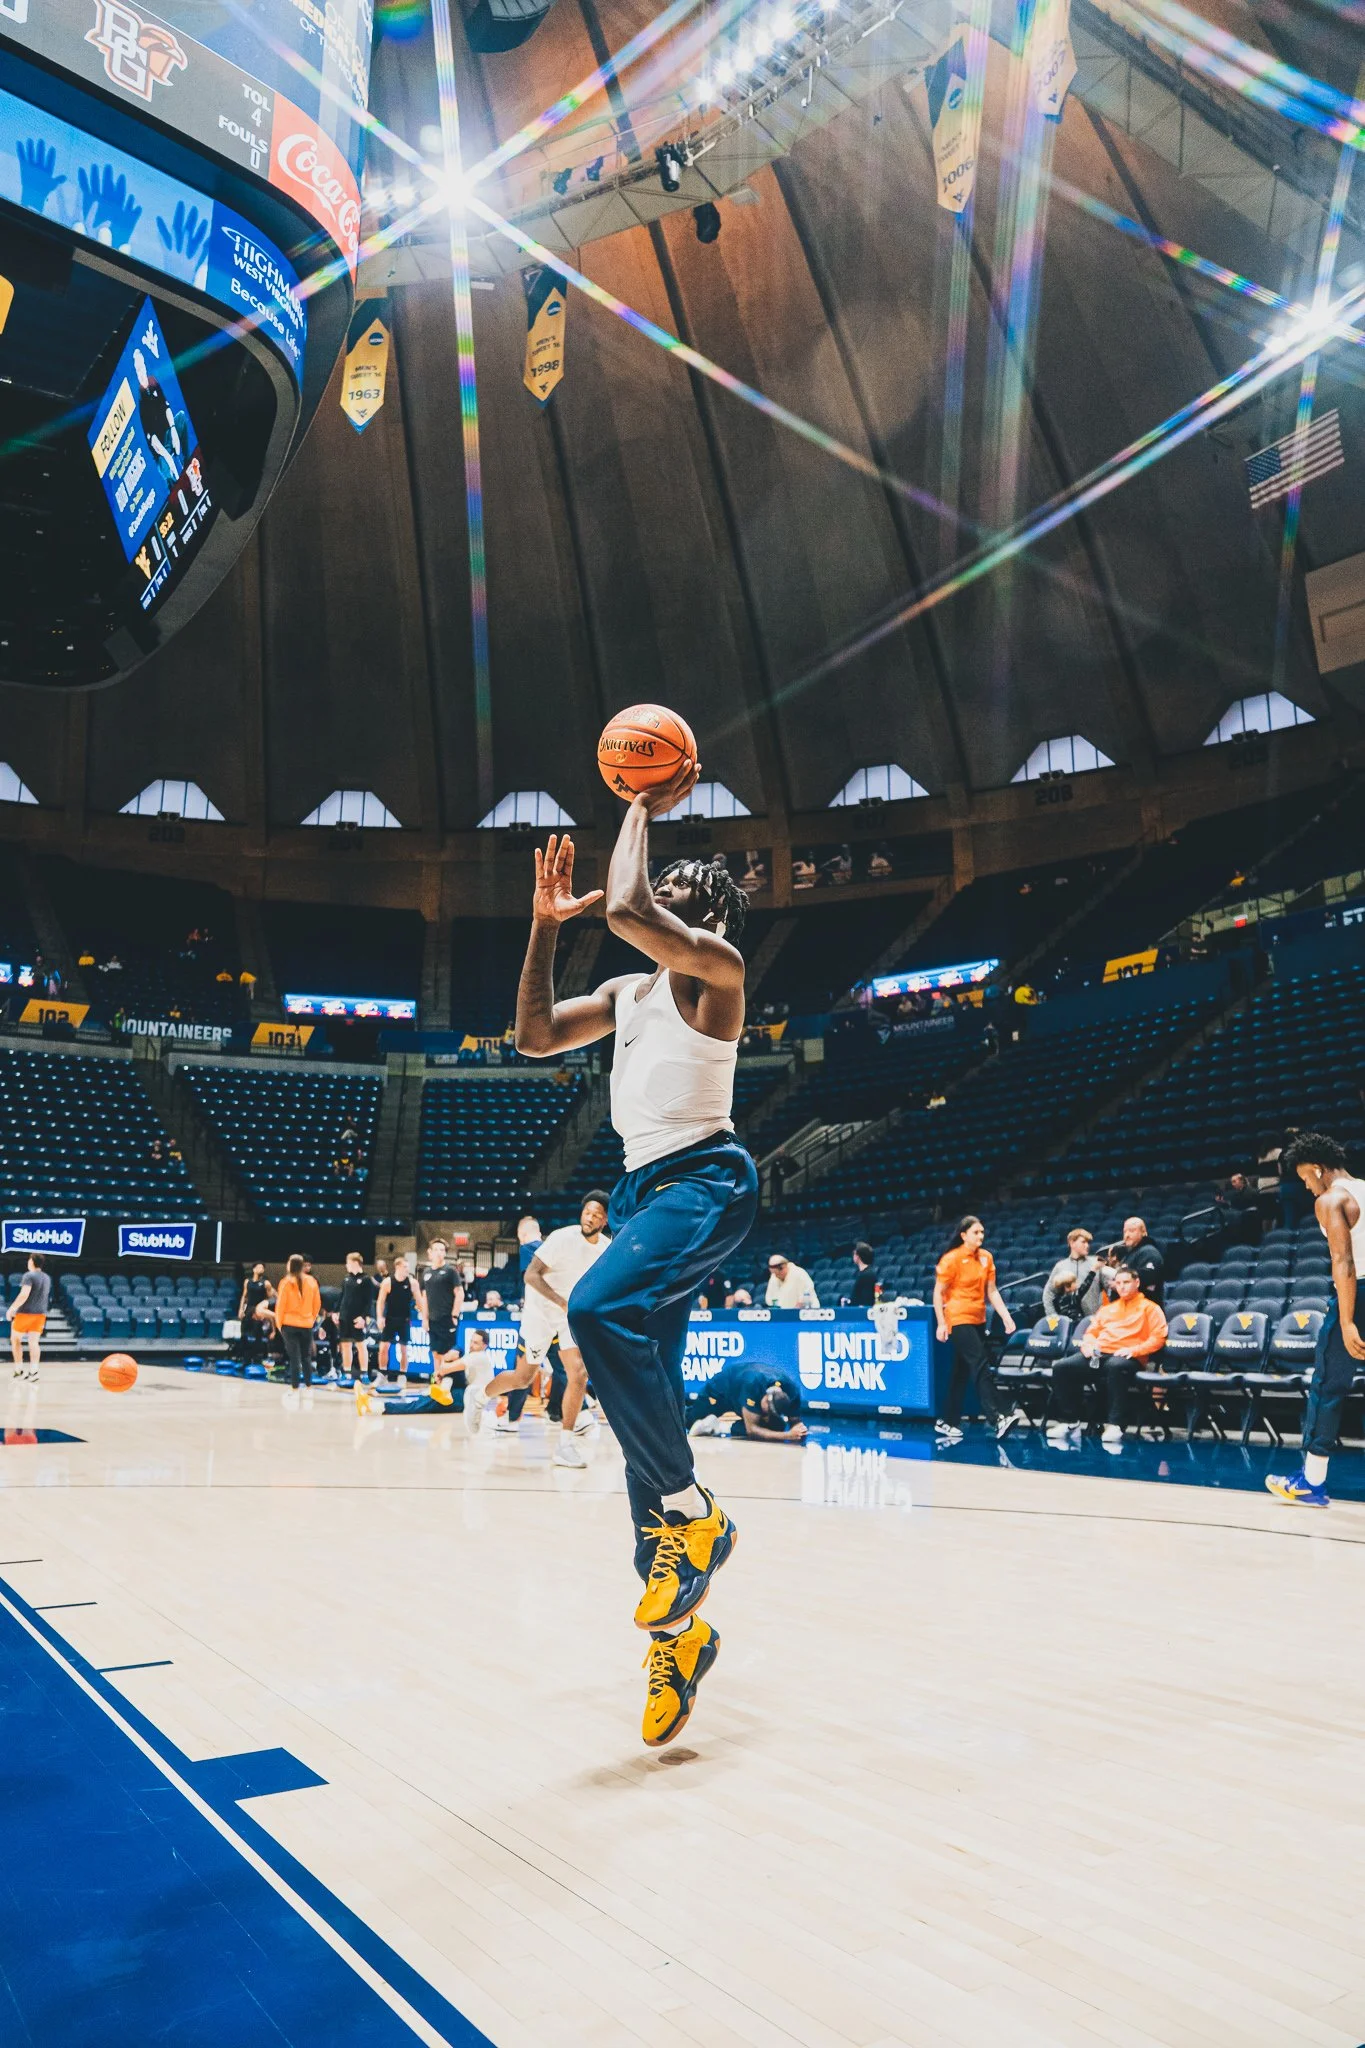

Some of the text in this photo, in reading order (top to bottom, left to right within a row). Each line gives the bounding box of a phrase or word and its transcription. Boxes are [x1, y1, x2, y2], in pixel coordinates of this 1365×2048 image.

[242, 84, 271, 112] TOL
[251, 108, 262, 127] 4
[218, 115, 268, 154] FOULS
[250, 149, 260, 169] 0
[234, 253, 299, 329] WEST VIRGINIA
[231, 278, 285, 334] Because
[531, 360, 560, 378] 1998
[348, 389, 381, 401] 1963
[101, 400, 126, 460] FOLLOW
[600, 737, 656, 758] SPALDING
[268, 1031, 297, 1047] 103
[13, 1228, 73, 1245] StubHub
[128, 1232, 185, 1249] StubHub
[825, 1361, 887, 1391] BANK
